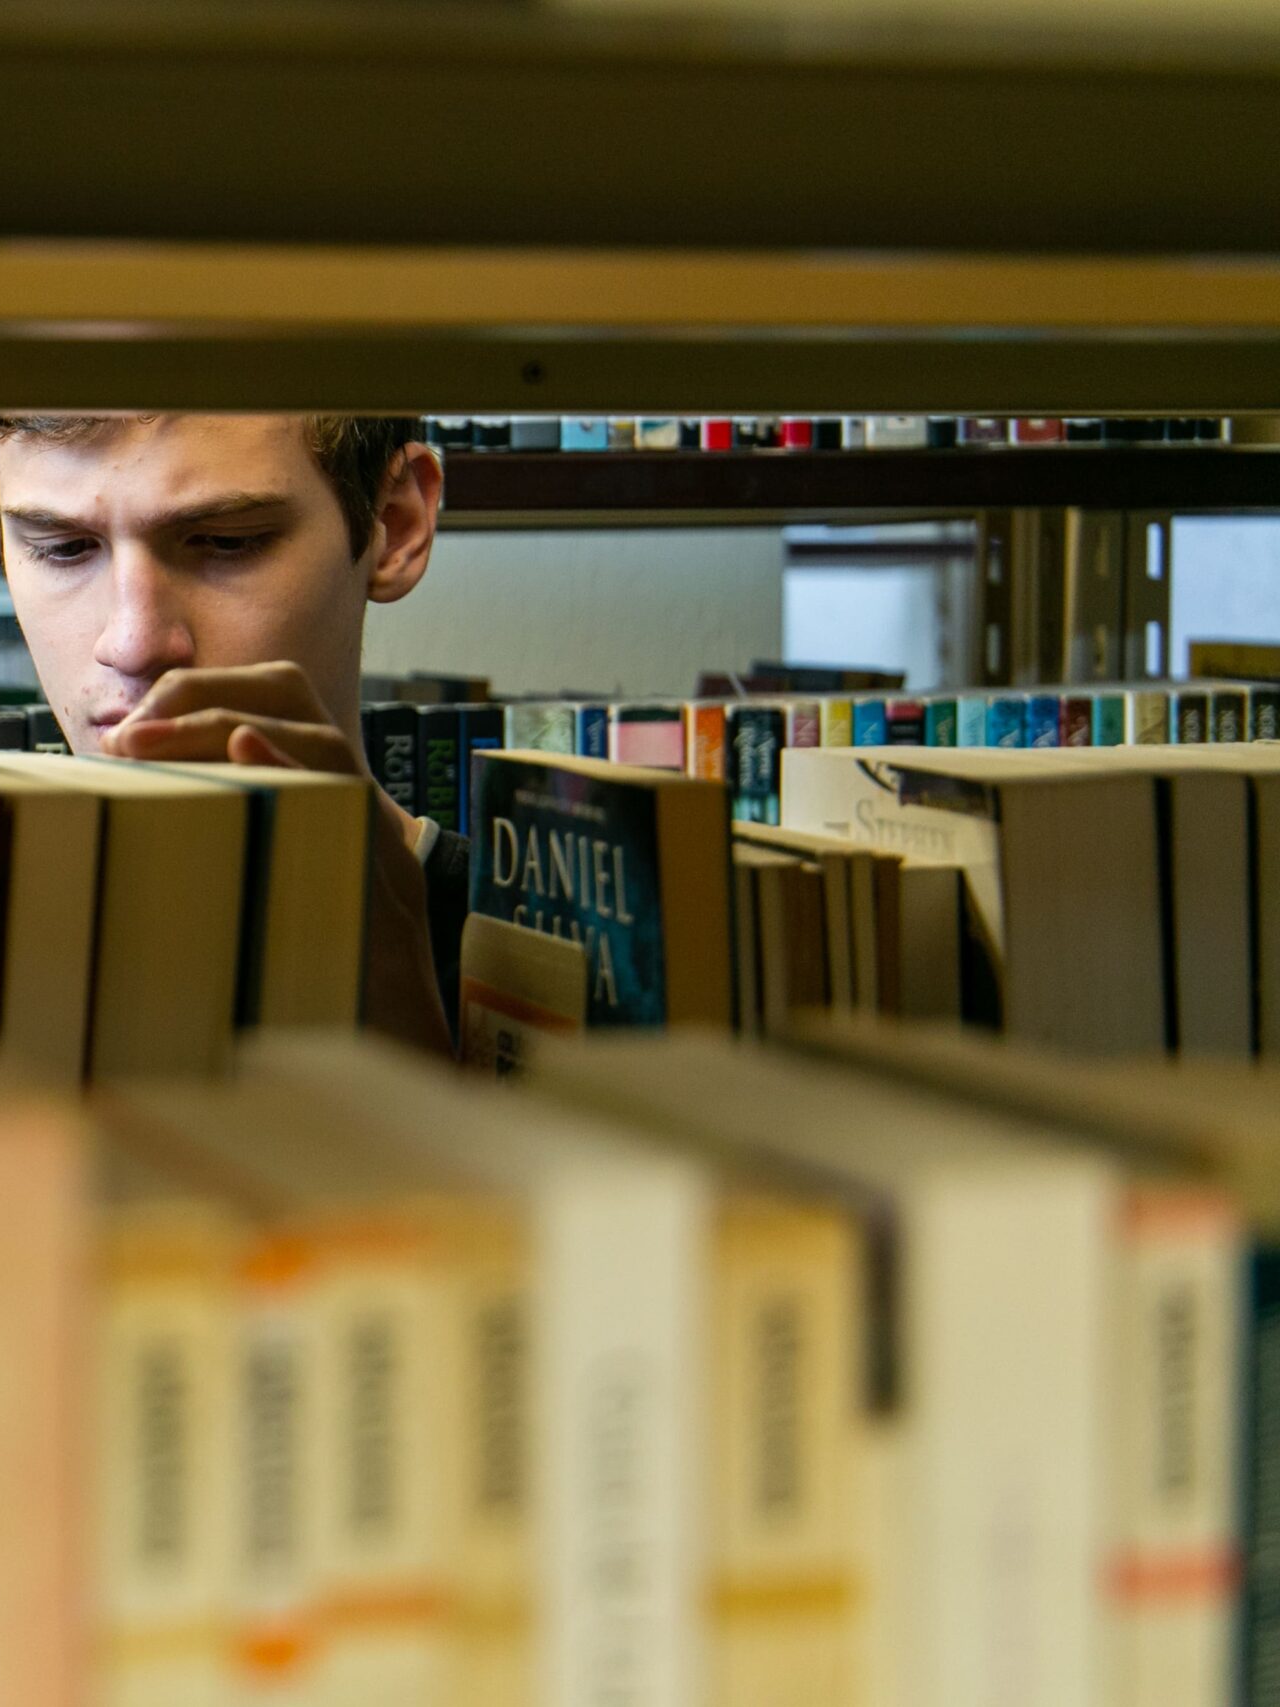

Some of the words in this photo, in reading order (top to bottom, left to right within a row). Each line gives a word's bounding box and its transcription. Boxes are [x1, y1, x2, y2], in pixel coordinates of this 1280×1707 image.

[1183, 708, 1199, 743] NOR
[1258, 704, 1275, 740] NOR
[384, 734, 415, 815] ROB
[492, 816, 635, 926] DANIEL
